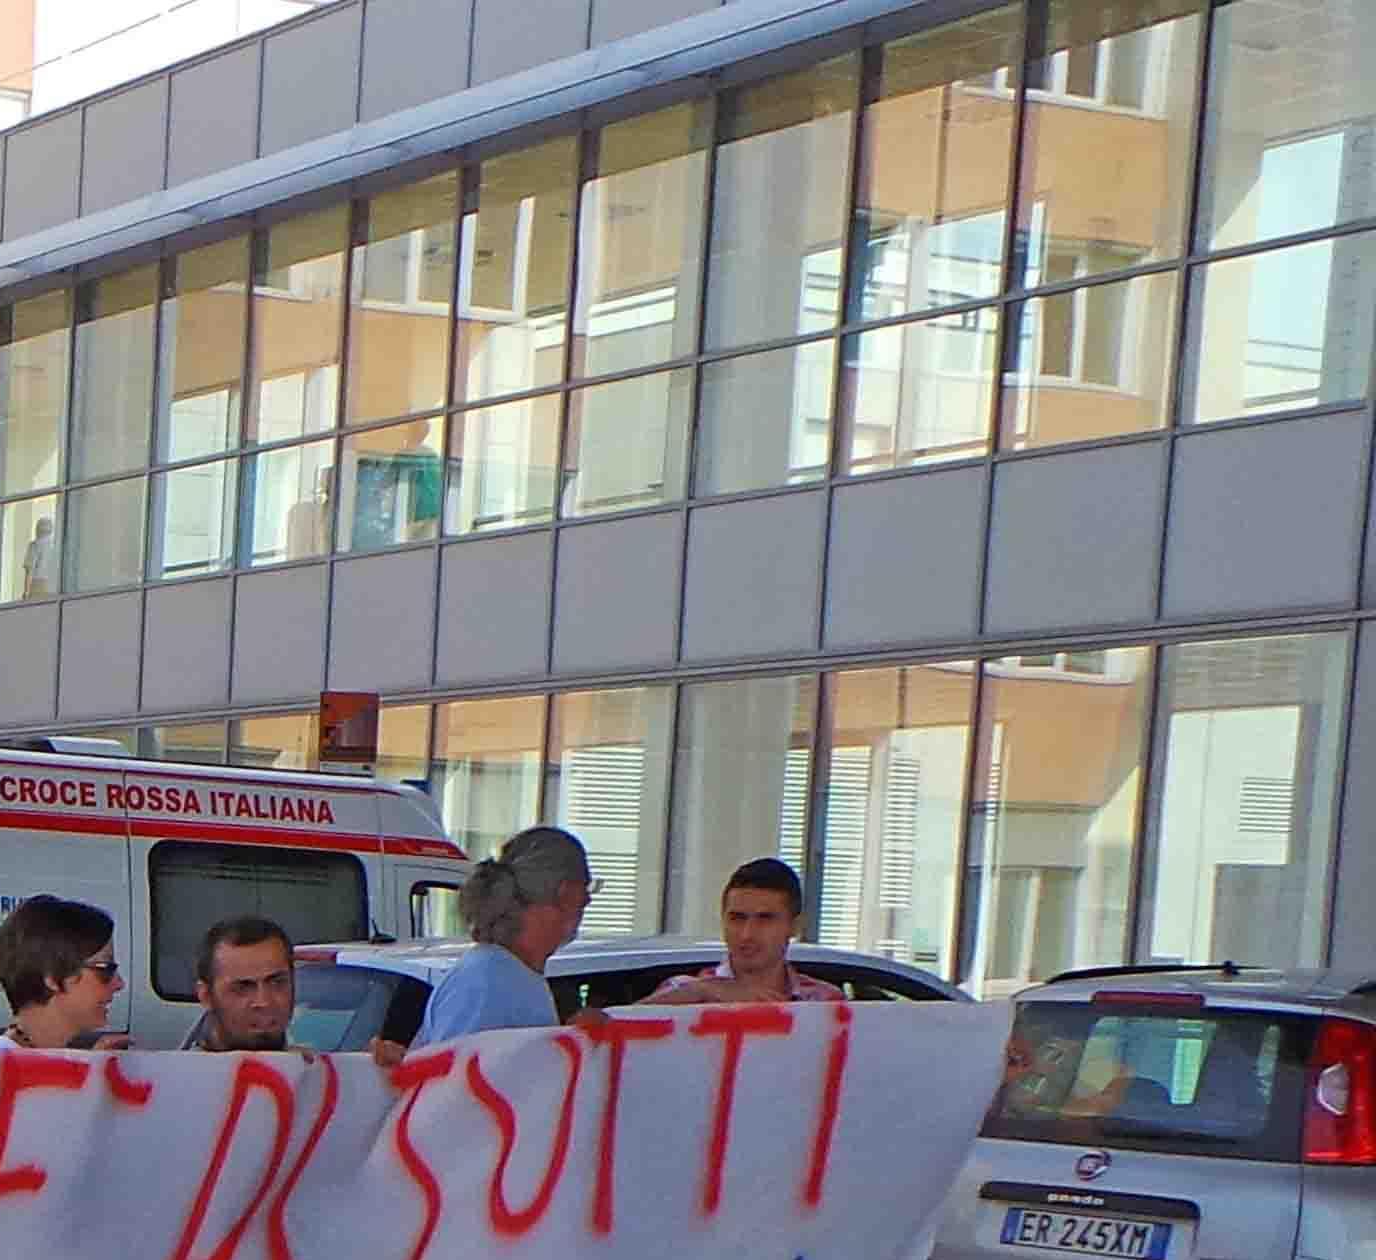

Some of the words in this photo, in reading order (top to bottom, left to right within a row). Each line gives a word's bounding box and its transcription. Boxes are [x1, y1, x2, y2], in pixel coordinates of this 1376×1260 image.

[106, 783, 201, 815] ROSSA
[210, 791, 335, 825] ITALIANA
[1018, 1213, 1053, 1244] ER
[1059, 1218, 1147, 1255] 245XM
